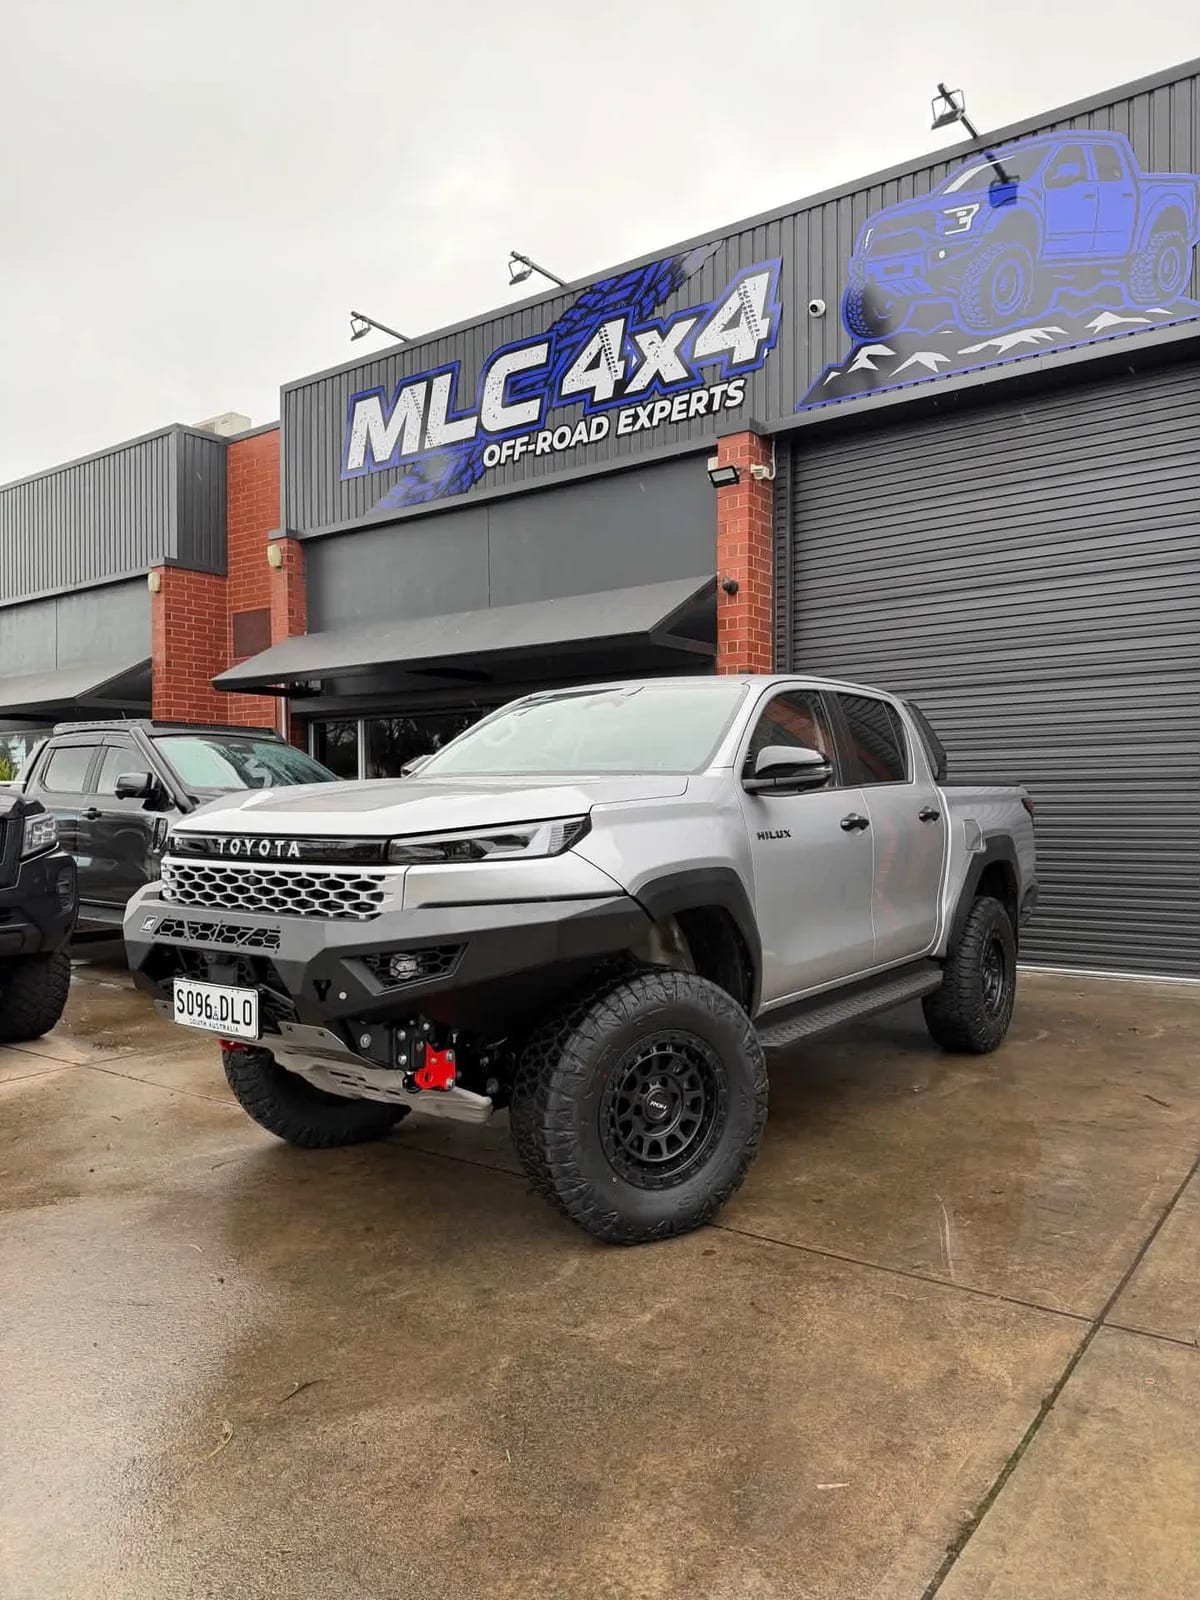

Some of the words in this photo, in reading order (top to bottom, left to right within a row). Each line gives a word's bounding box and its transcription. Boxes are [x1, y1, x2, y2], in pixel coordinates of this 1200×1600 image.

[347, 342, 549, 470] MLC
[562, 272, 771, 402] 4x4
[483, 415, 607, 468] OFF-ROAD
[616, 379, 746, 437] EXPERTS
[217, 838, 300, 857] TOYOTA
[757, 830, 791, 840] HILUX
